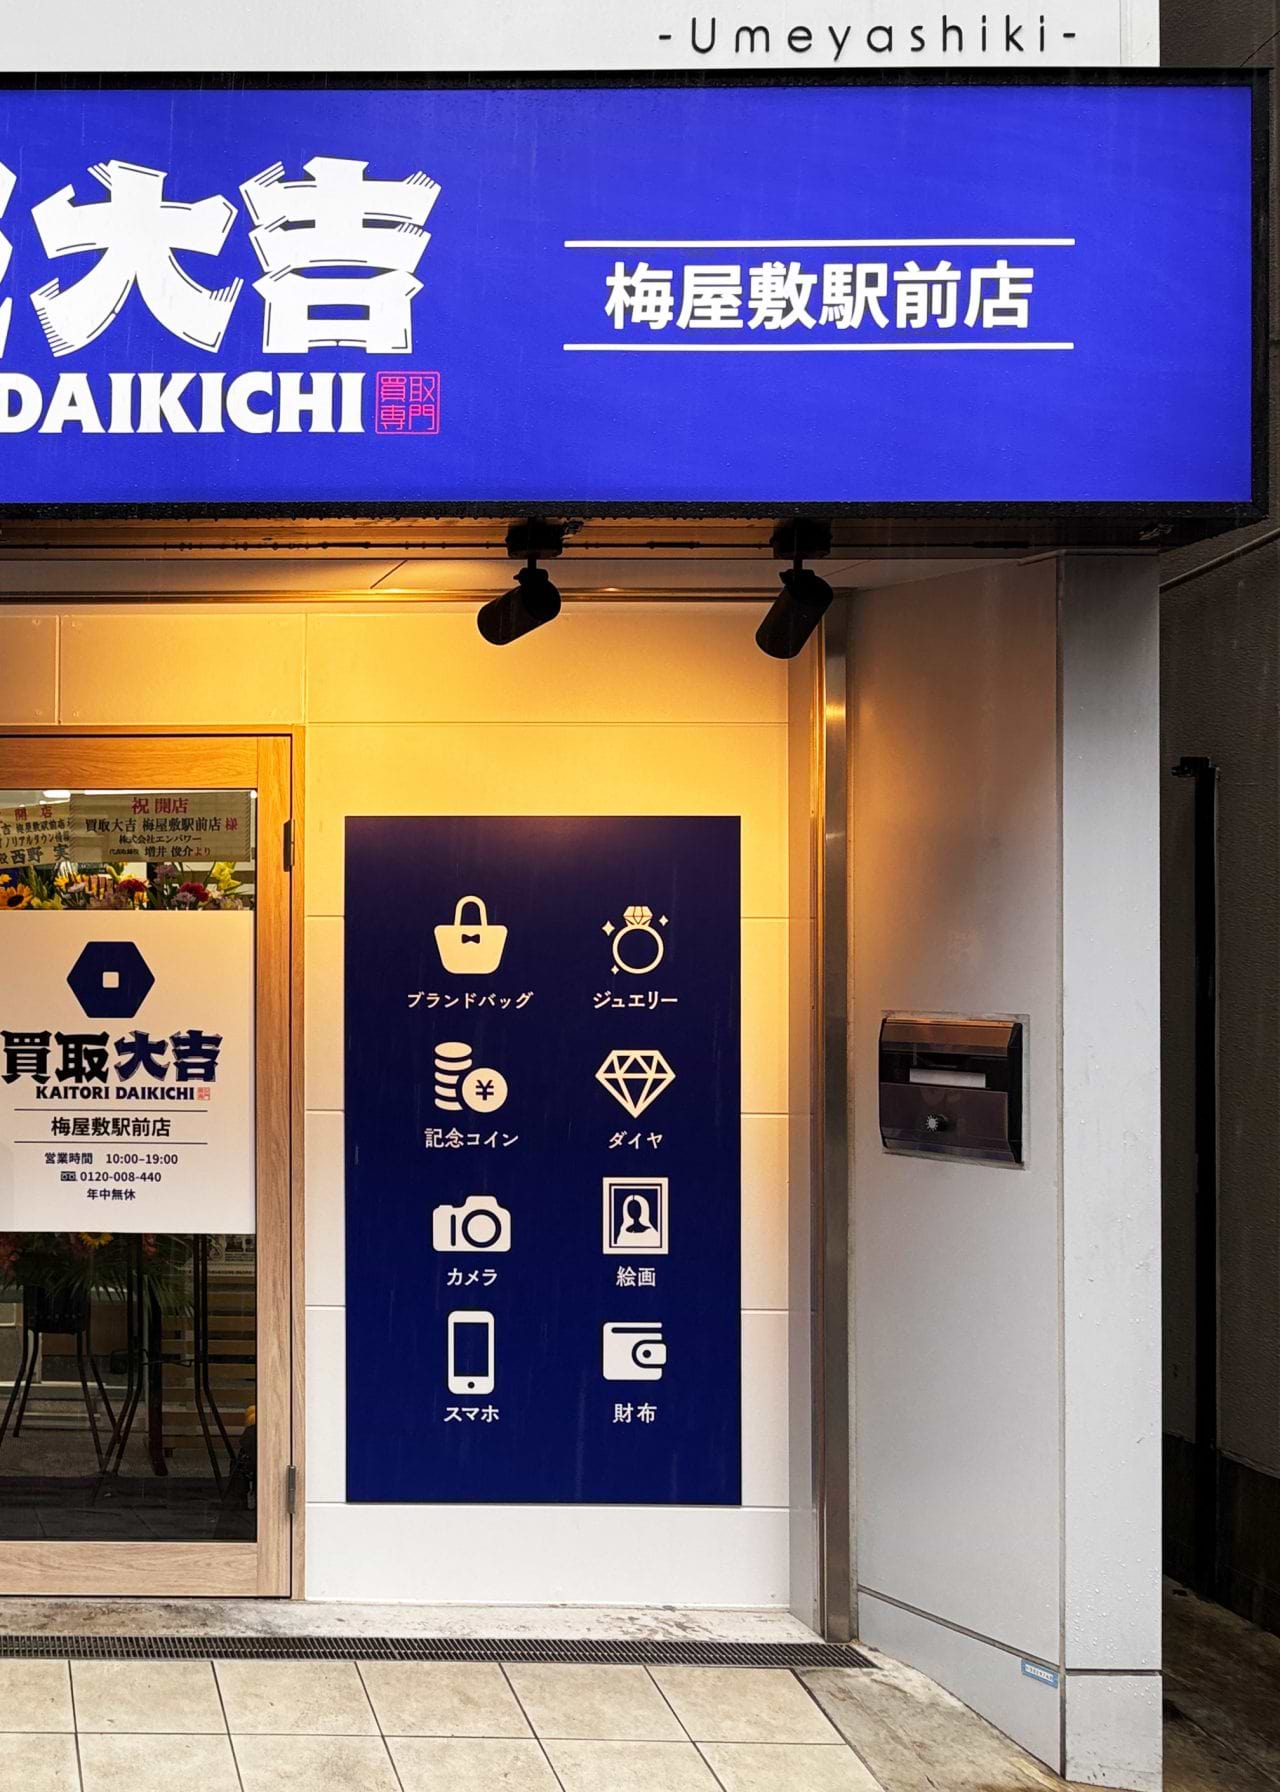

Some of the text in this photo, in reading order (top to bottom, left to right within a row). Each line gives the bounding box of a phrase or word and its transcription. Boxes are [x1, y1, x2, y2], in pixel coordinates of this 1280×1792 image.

[659, 15, 1075, 62] -Umeyashiki-
[604, 260, 1034, 330] 梅屋敷駅前店
[131, 797, 189, 815] 祝 開店
[85, 818, 137, 833] 買取大吉
[142, 817, 222, 832] 梅屋敷駅前店
[407, 991, 534, 1009] ブランドバッグ
[593, 991, 678, 1009] ジュエリー
[0, 1029, 223, 1084] 買取大吉
[36, 1086, 110, 1100] KAITORI
[116, 1087, 195, 1101] DAIKICHI
[51, 1116, 171, 1137] 梅屋敷駅前店
[424, 1127, 519, 1149] 記念コイン
[608, 1131, 663, 1150] ダイヤ
[44, 1152, 93, 1165] 営業時間
[80, 1171, 162, 1182] 0120-008-440
[86, 1188, 136, 1201] 年中無休
[446, 1268, 498, 1287] カメラ
[616, 1266, 656, 1287] 絵画
[443, 1405, 500, 1423] スマホ
[612, 1403, 657, 1423] 財布
